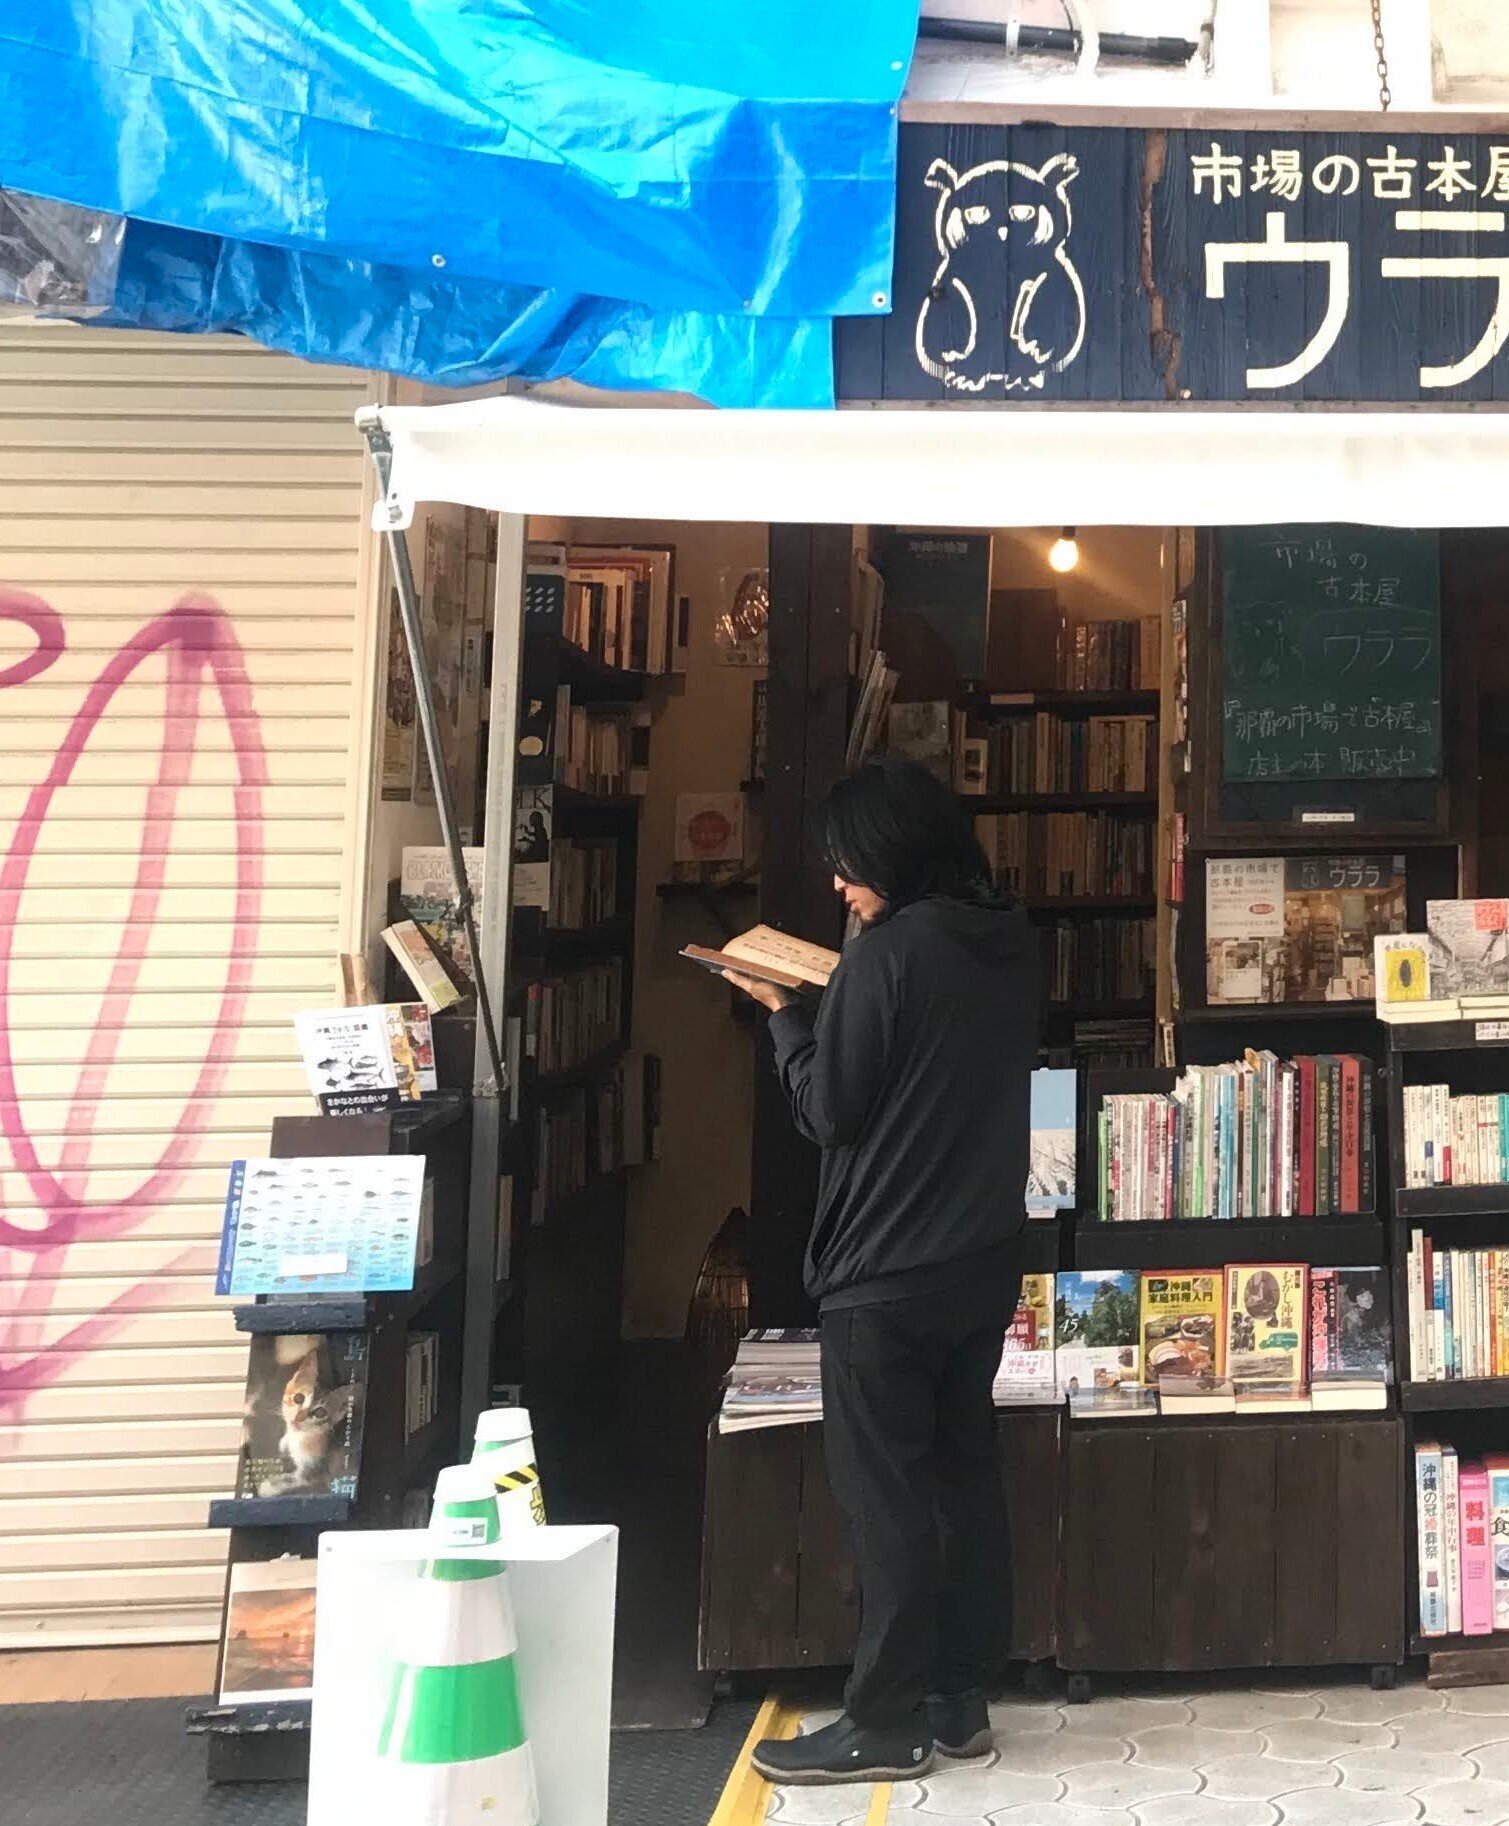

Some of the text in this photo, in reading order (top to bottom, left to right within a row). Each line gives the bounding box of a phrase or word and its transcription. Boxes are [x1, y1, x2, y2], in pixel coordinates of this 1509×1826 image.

[1318, 576, 1402, 607] 古本屋
[1323, 623, 1433, 676] ウララ
[1329, 864, 1381, 888] ウララ
[1059, 1318, 1079, 1333] 45
[1465, 1501, 1486, 1547] 料理
